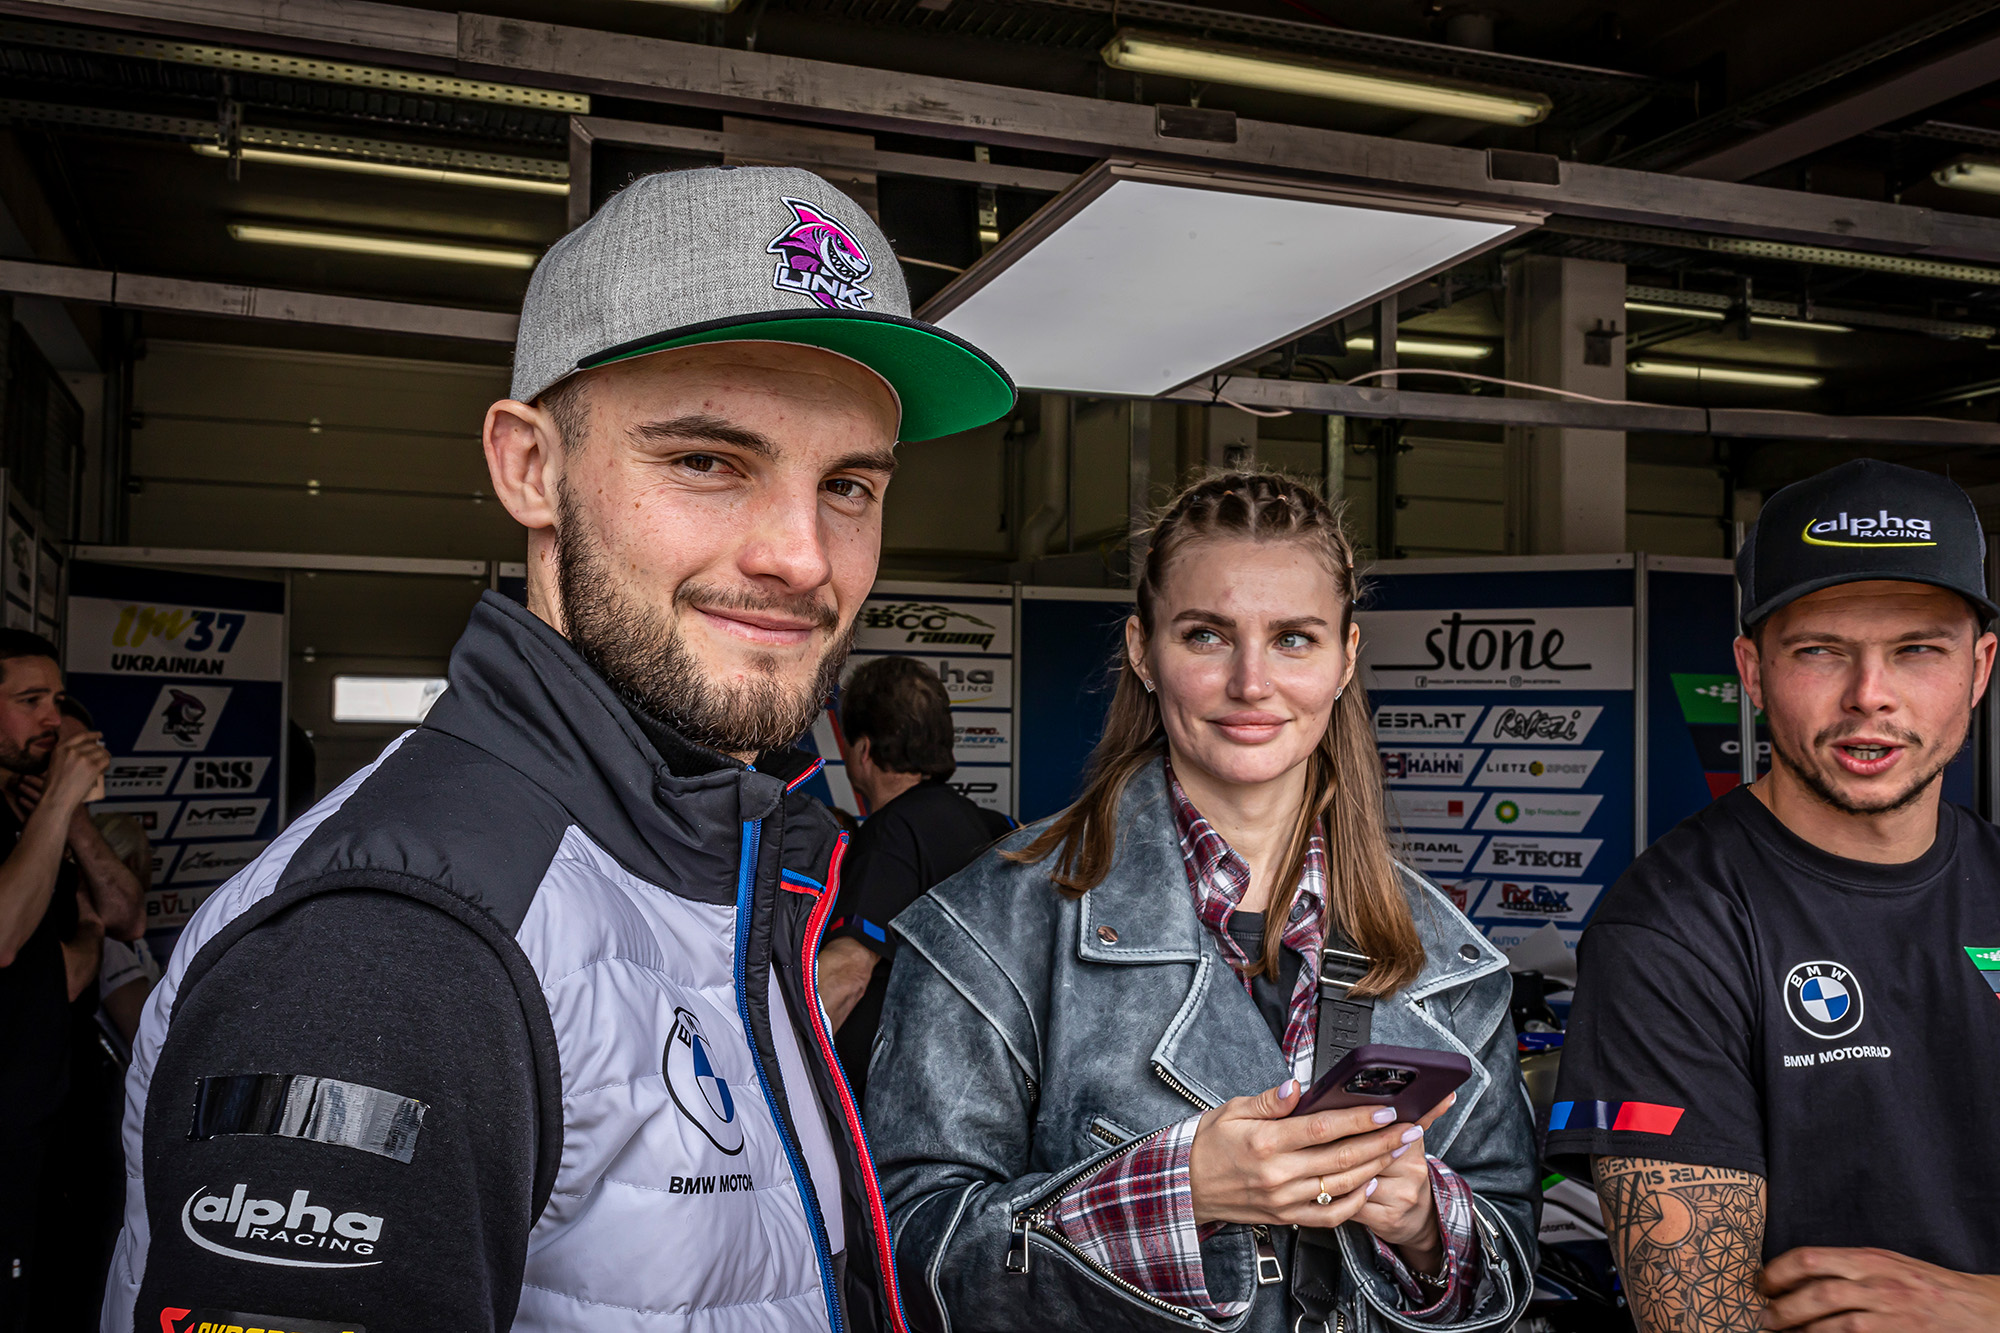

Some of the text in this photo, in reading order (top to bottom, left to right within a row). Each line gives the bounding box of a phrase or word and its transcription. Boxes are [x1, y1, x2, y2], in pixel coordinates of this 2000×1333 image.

[778, 267, 861, 307] LINK
[1811, 510, 1932, 536] alpha
[1859, 529, 1932, 540] RACING
[866, 613, 948, 631] BCC
[905, 631, 996, 651] racing
[1371, 612, 1592, 671] stone
[111, 653, 224, 675] UKRAINIAN
[947, 684, 993, 693] CING
[105, 766, 168, 779] S2
[1407, 759, 1459, 774] HAHN
[1486, 763, 1588, 774] LIETZ SPORT
[1492, 849, 1583, 868] E-TECH
[1790, 965, 1847, 989] BMW
[1783, 1045, 1892, 1068] BMW MOTORRAD
[668, 1173, 755, 1195] BMW MOTOR
[1646, 1166, 1748, 1186] IS RELATIVE
[193, 1183, 384, 1242] alpha
[249, 1226, 375, 1256] RACING
